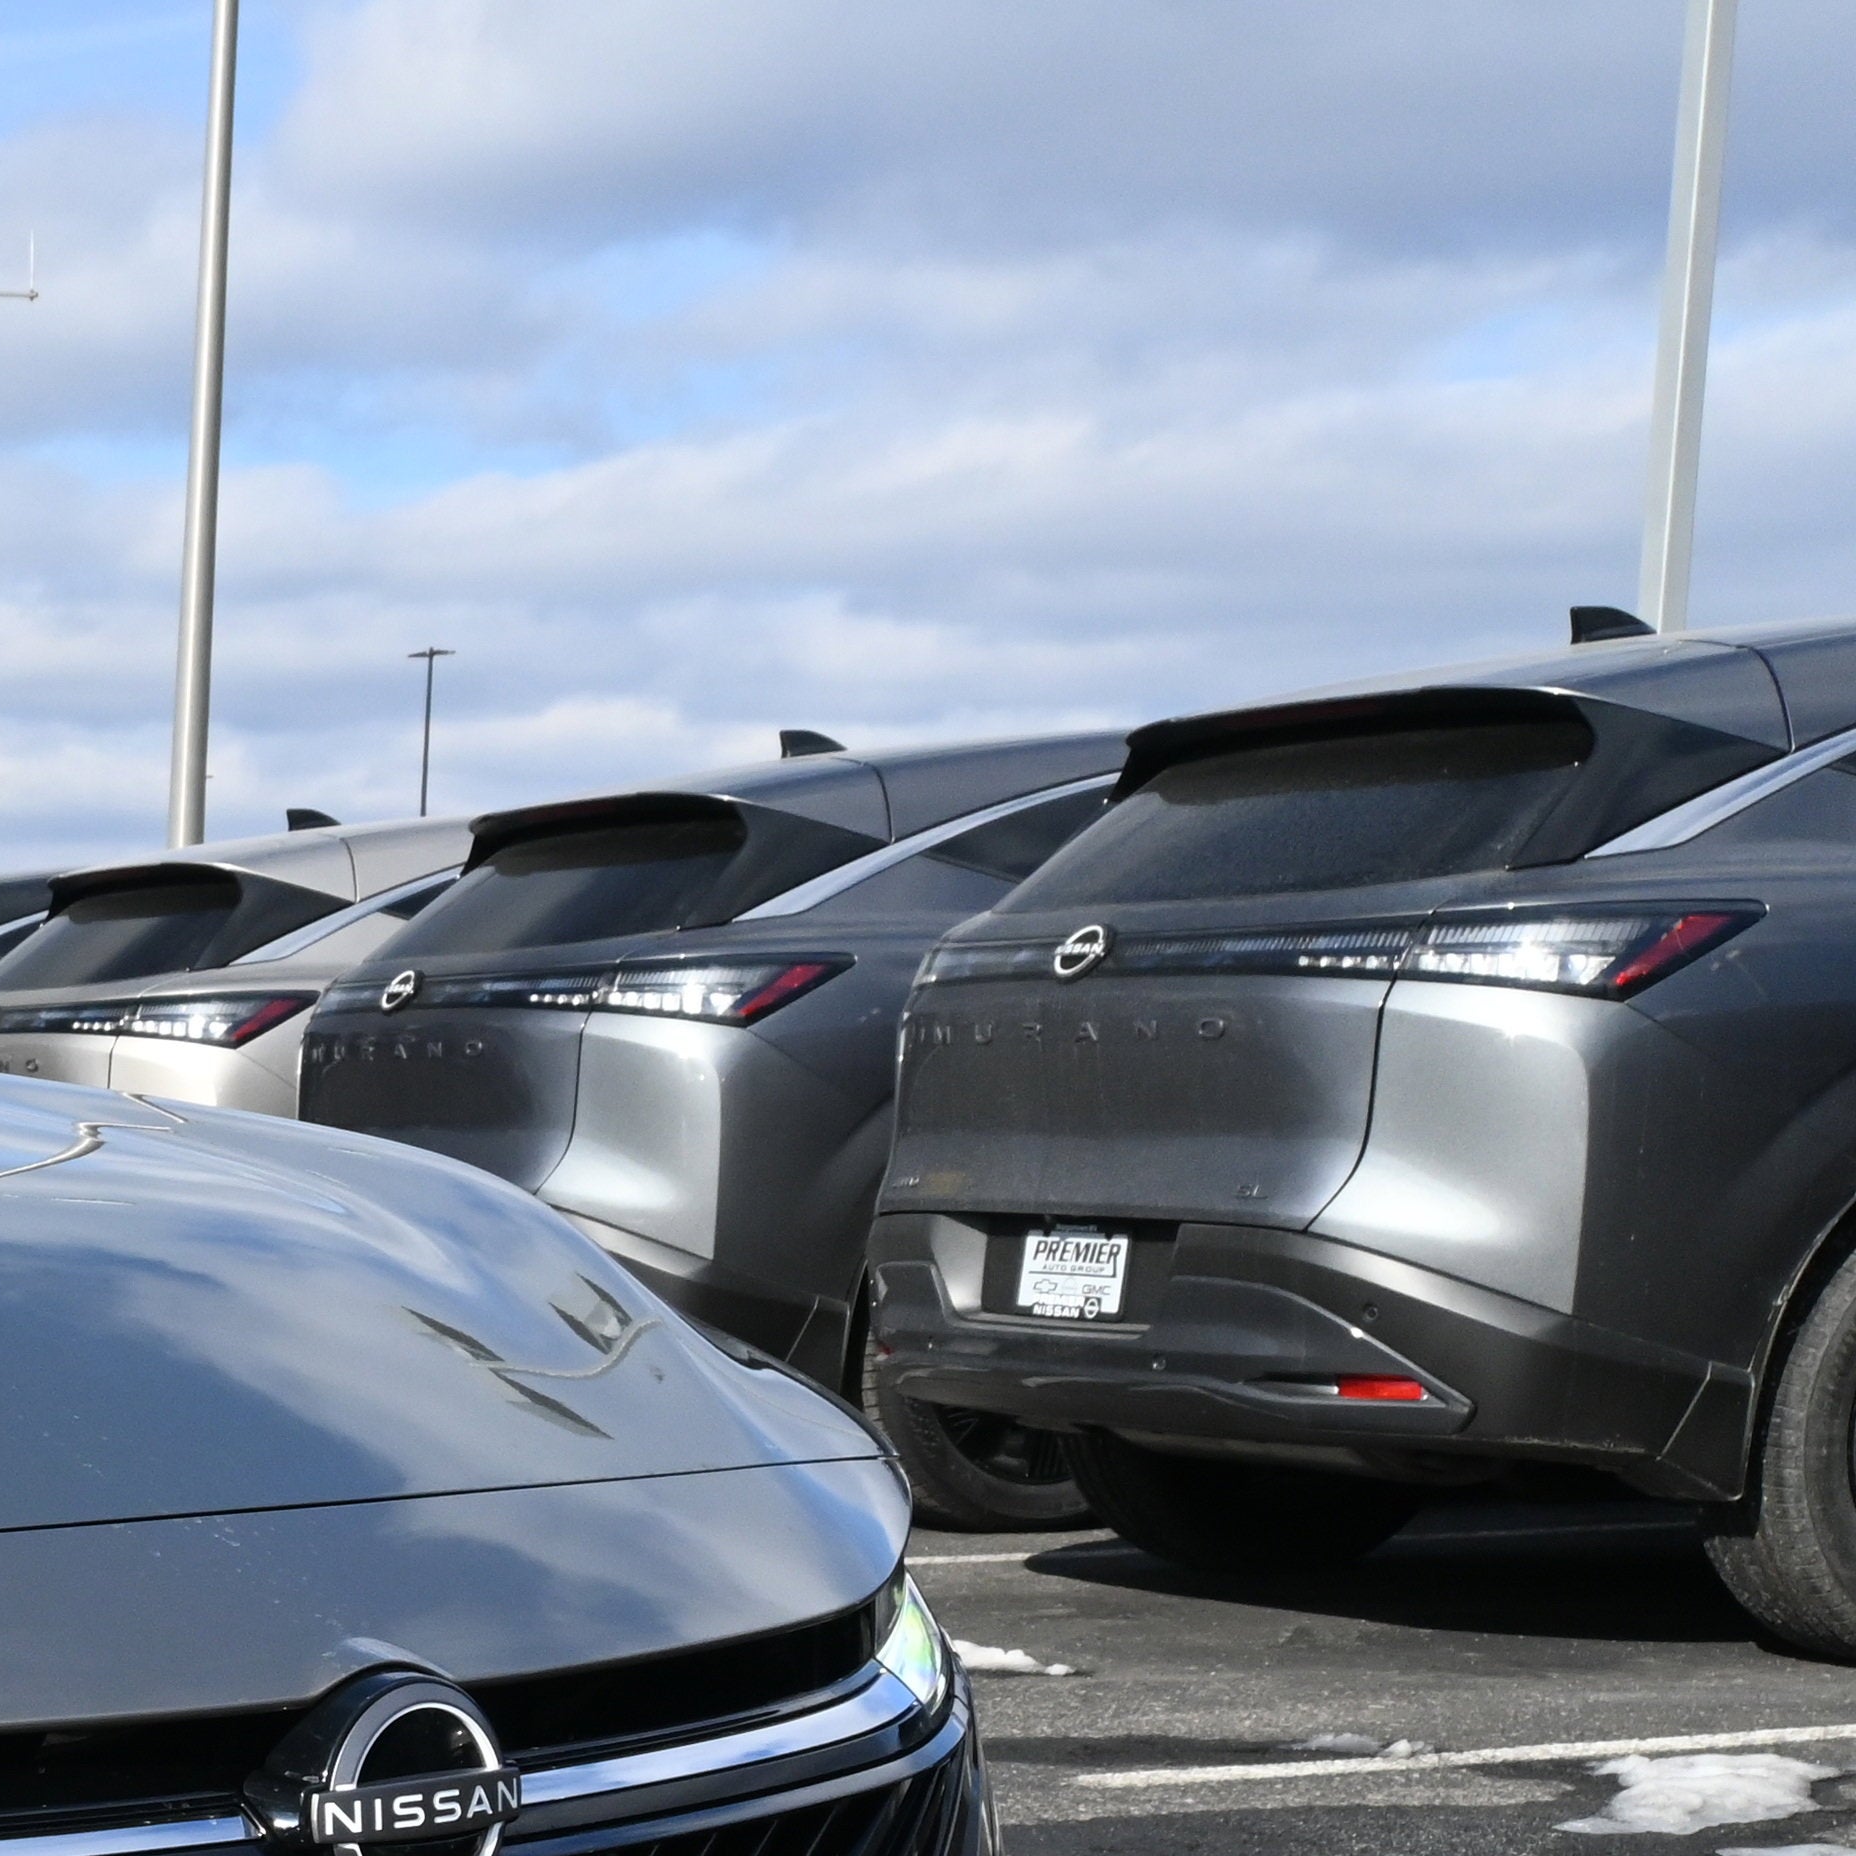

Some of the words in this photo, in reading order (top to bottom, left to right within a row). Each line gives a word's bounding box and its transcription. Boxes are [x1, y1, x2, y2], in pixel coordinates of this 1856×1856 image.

[934, 1018, 1225, 1045] MURANO
[1033, 1240, 1121, 1264] PREMIER
[1042, 1263, 1067, 1271] AUTO
[1070, 1265, 1106, 1273] GROUP
[1081, 1284, 1111, 1296] GMC
[1032, 1303, 1081, 1319] NISSAN
[324, 1776, 520, 1836] NISSAN
